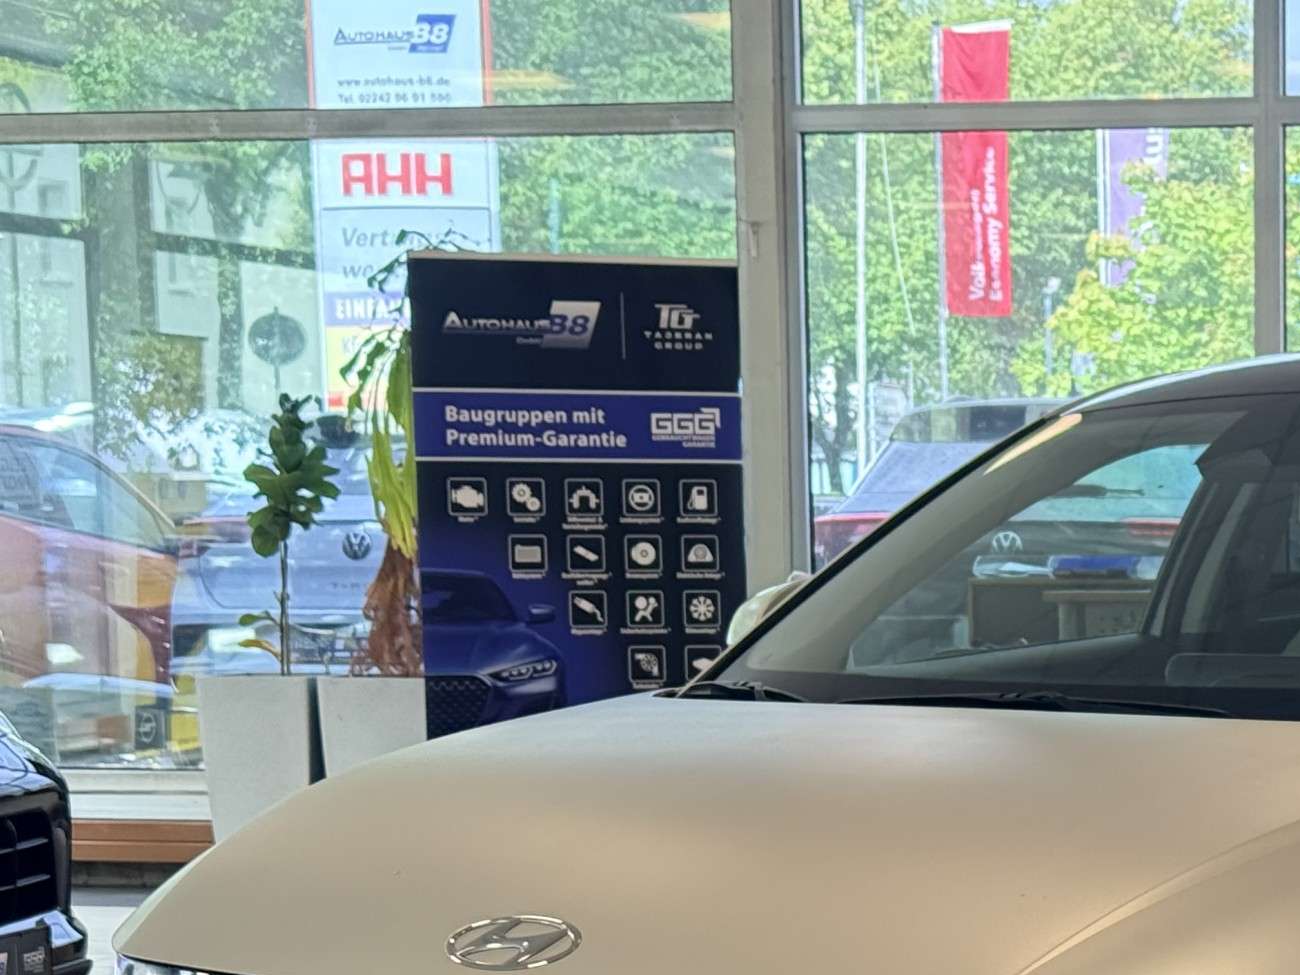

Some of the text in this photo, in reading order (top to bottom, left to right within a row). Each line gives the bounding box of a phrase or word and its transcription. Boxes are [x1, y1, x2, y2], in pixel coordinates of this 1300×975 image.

[341, 153, 453, 196] AHH
[442, 311, 552, 332] AUTOHAUS
[445, 405, 605, 427] Baugruppen mit
[650, 410, 718, 435] GGG
[446, 430, 627, 448] Premium-Garantie
